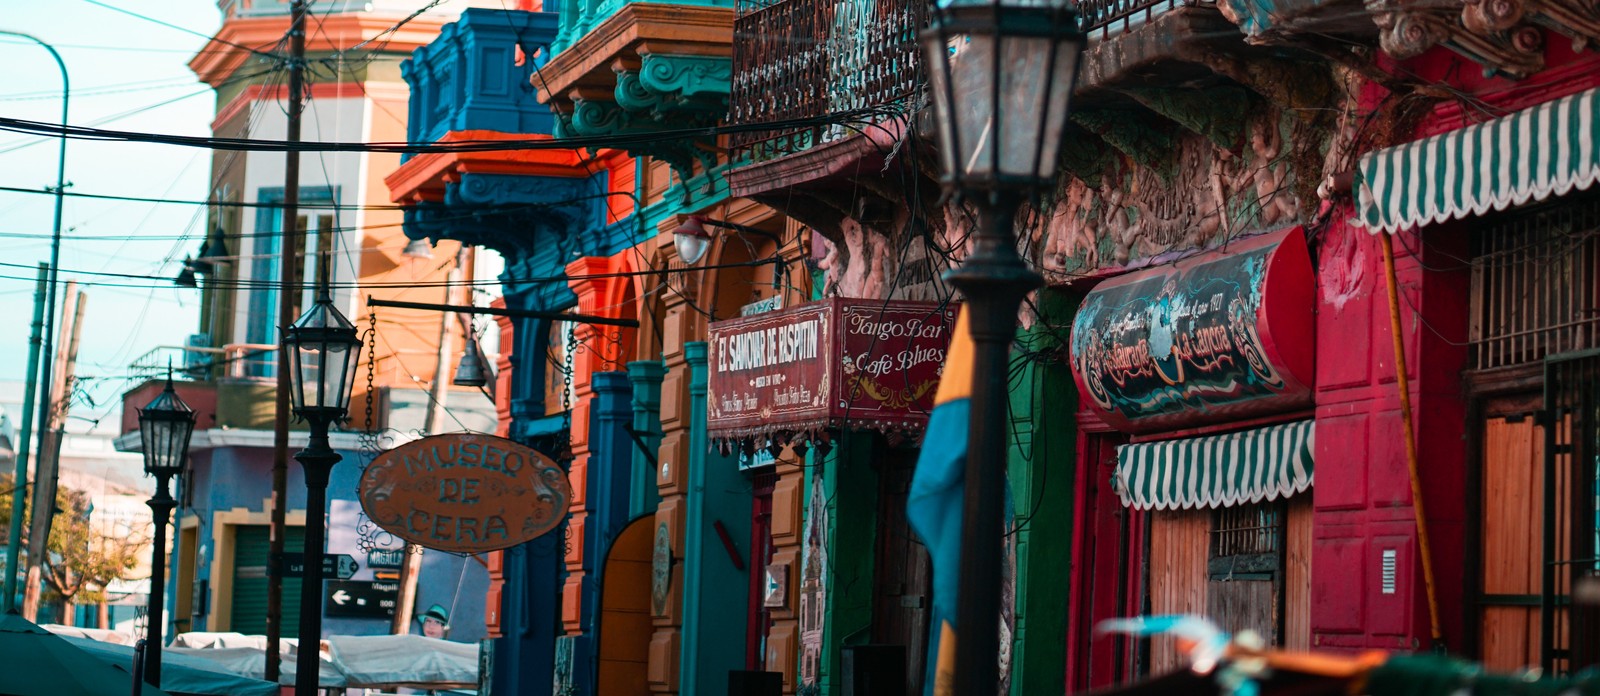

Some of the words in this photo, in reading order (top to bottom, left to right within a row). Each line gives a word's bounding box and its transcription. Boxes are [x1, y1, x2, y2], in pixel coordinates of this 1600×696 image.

[849, 313, 904, 340] Tango
[904, 319, 945, 338] Bar
[718, 336, 727, 372] EL
[729, 330, 766, 371] SAMOVAR
[767, 327, 777, 366] DE
[778, 320, 818, 363] RASPUTIN
[856, 352, 893, 378] Café
[895, 344, 943, 371] Blues
[403, 442, 523, 478] MUSEO
[437, 478, 480, 503] DE
[406, 508, 508, 543] CERA
[369, 550, 403, 565] MAGALLA
